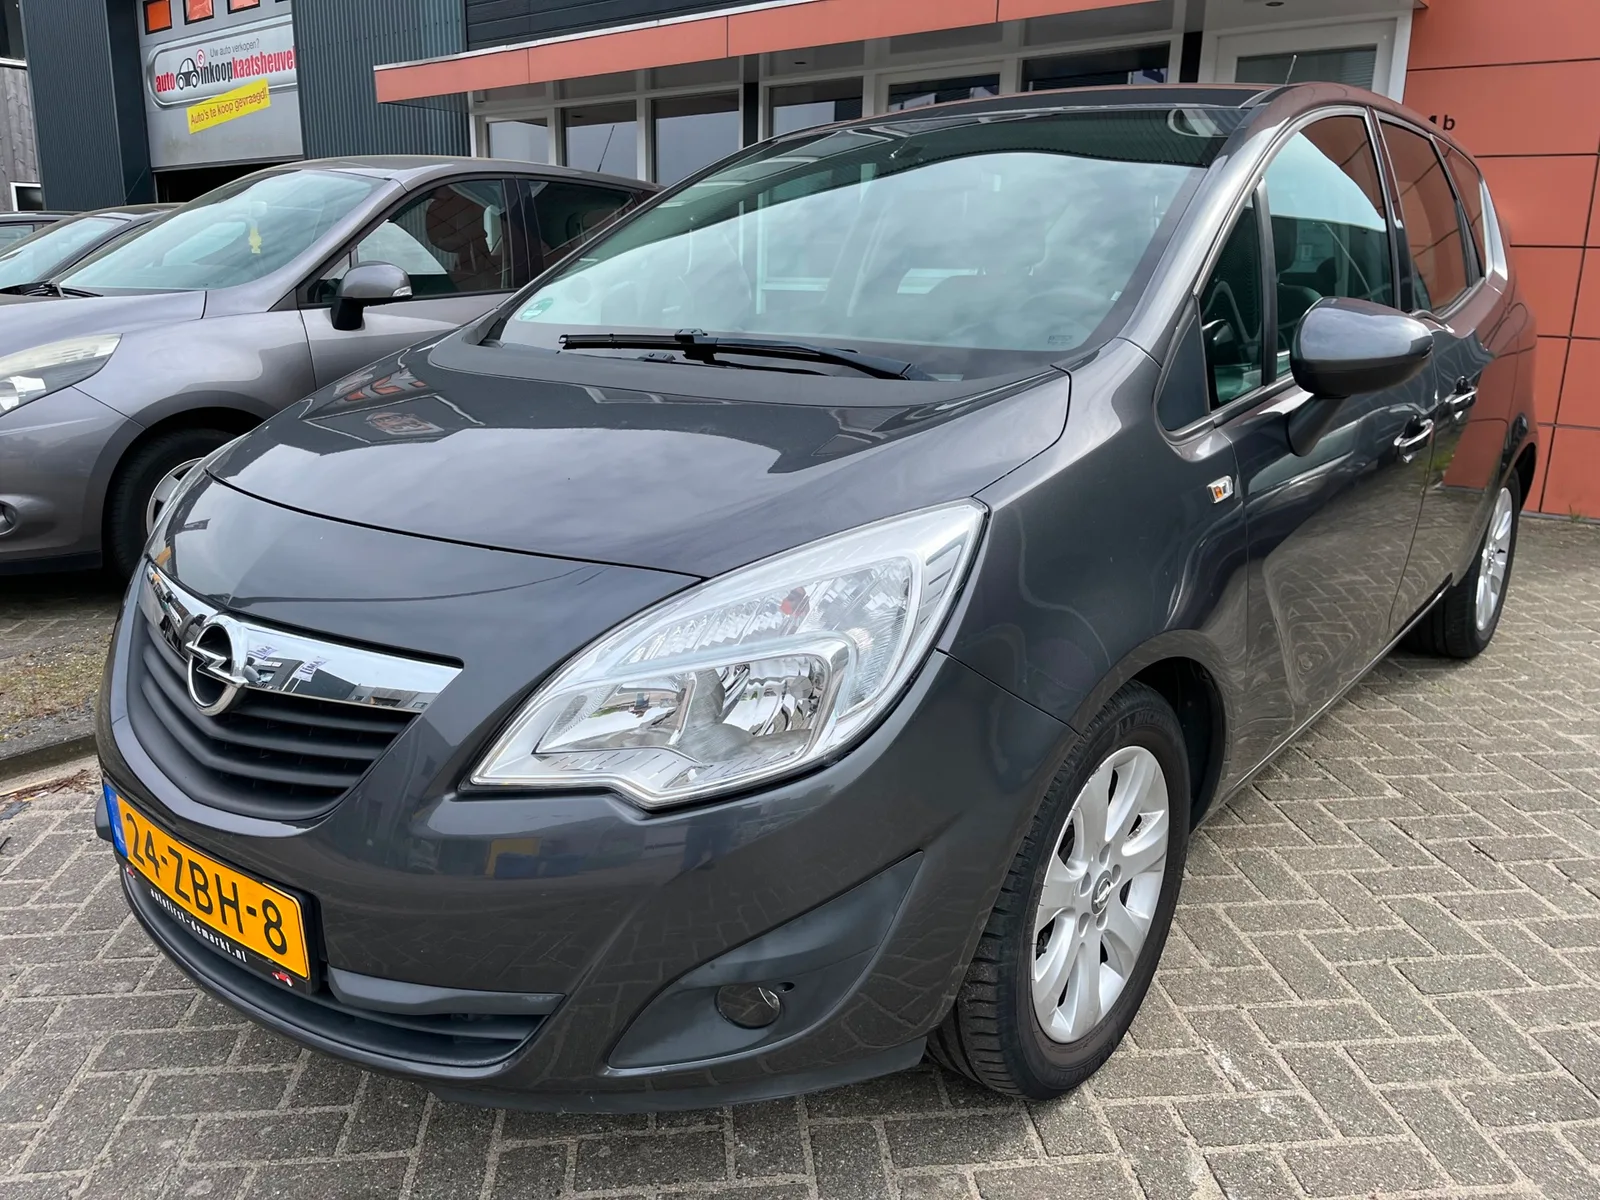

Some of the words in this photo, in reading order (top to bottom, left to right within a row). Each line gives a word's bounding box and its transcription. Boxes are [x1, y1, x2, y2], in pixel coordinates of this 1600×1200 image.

[209, 48, 219, 58] Uw
[219, 45, 232, 56] auto
[232, 37, 260, 54] verkopen?
[156, 71, 176, 93] auto
[190, 106, 210, 125] Auto's
[210, 106, 217, 117] te
[217, 100, 234, 116] koop
[234, 86, 268, 112] gevraagd!
[125, 812, 288, 956] 24-ZBH-8
[150, 888, 248, 963] autofirst-demarkt.nl
